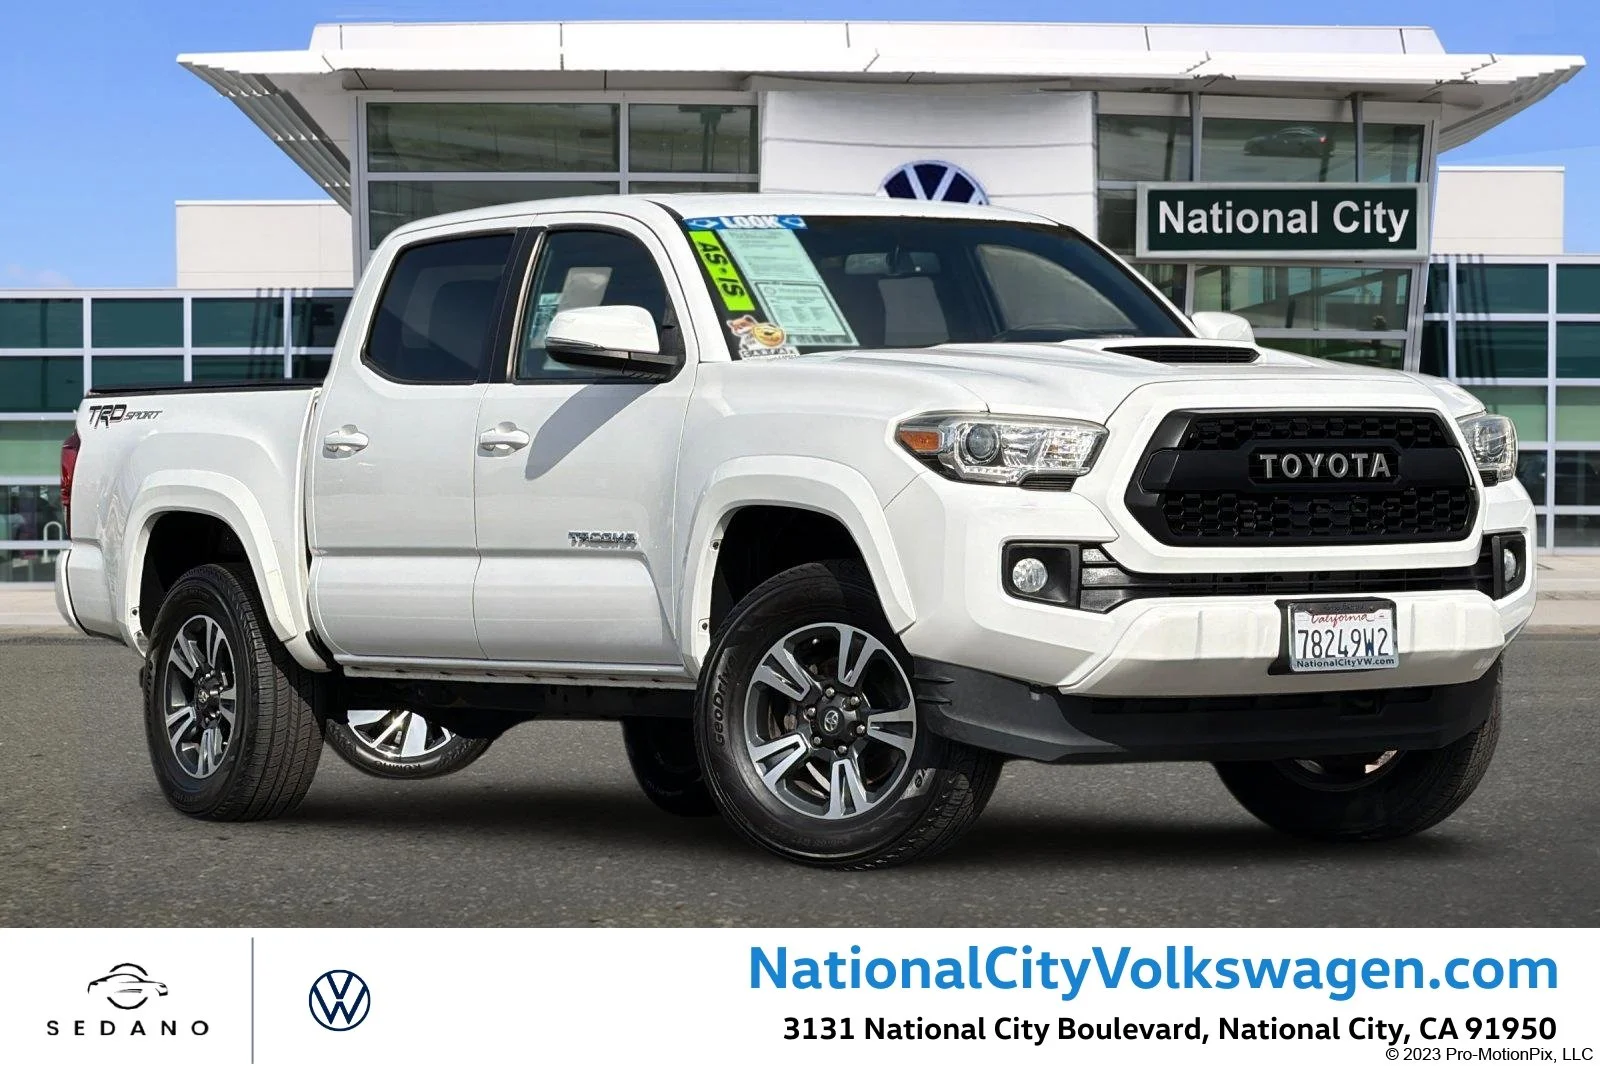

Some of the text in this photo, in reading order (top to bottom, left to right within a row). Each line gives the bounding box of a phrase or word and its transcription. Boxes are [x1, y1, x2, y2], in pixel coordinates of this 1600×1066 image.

[718, 215, 787, 230] LOOK
[1158, 200, 1410, 243] National City
[89, 404, 163, 429] TRD SPORT
[1259, 453, 1391, 479] TOYOTA
[567, 531, 638, 549] TACOMA
[1311, 613, 1375, 628] California
[1298, 628, 1389, 659] 78249W2
[1296, 657, 1395, 669] NationalCityVW.com
